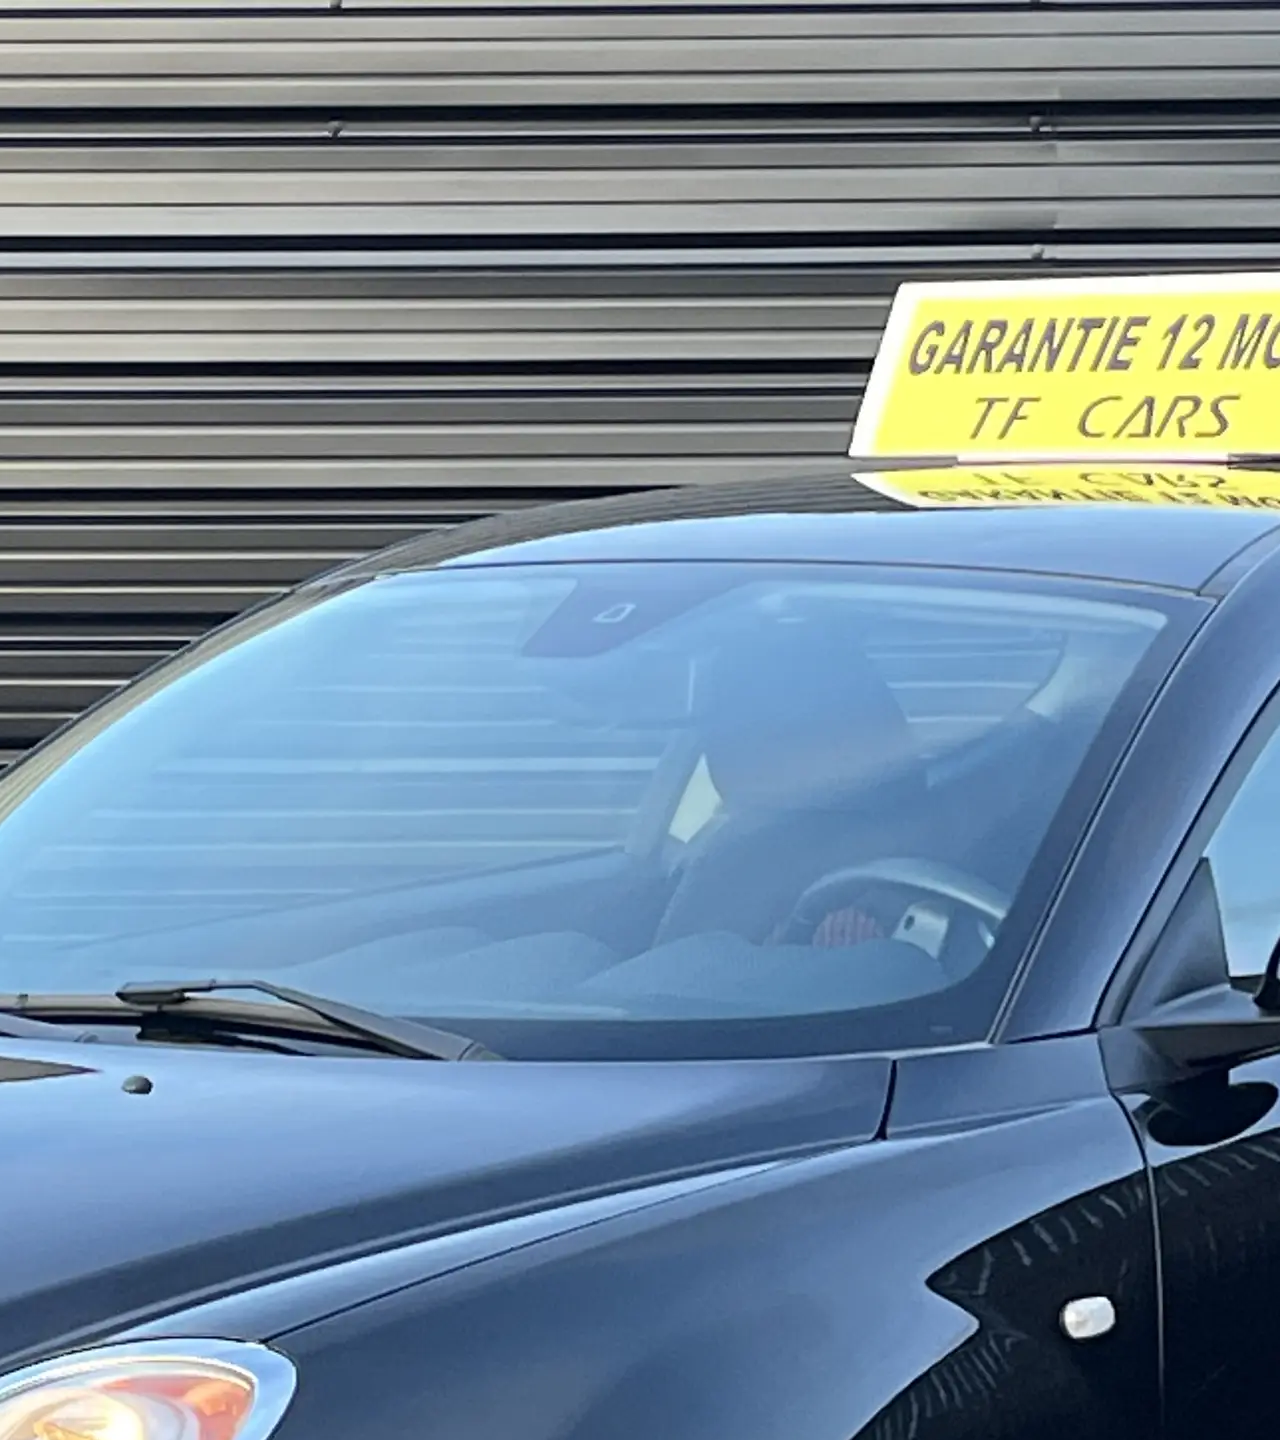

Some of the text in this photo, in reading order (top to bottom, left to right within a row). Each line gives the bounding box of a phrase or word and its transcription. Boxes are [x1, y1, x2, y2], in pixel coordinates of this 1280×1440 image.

[909, 317, 1149, 375] GARANTIE
[1157, 315, 1216, 372] 12
[967, 394, 1242, 440] TF CARS
